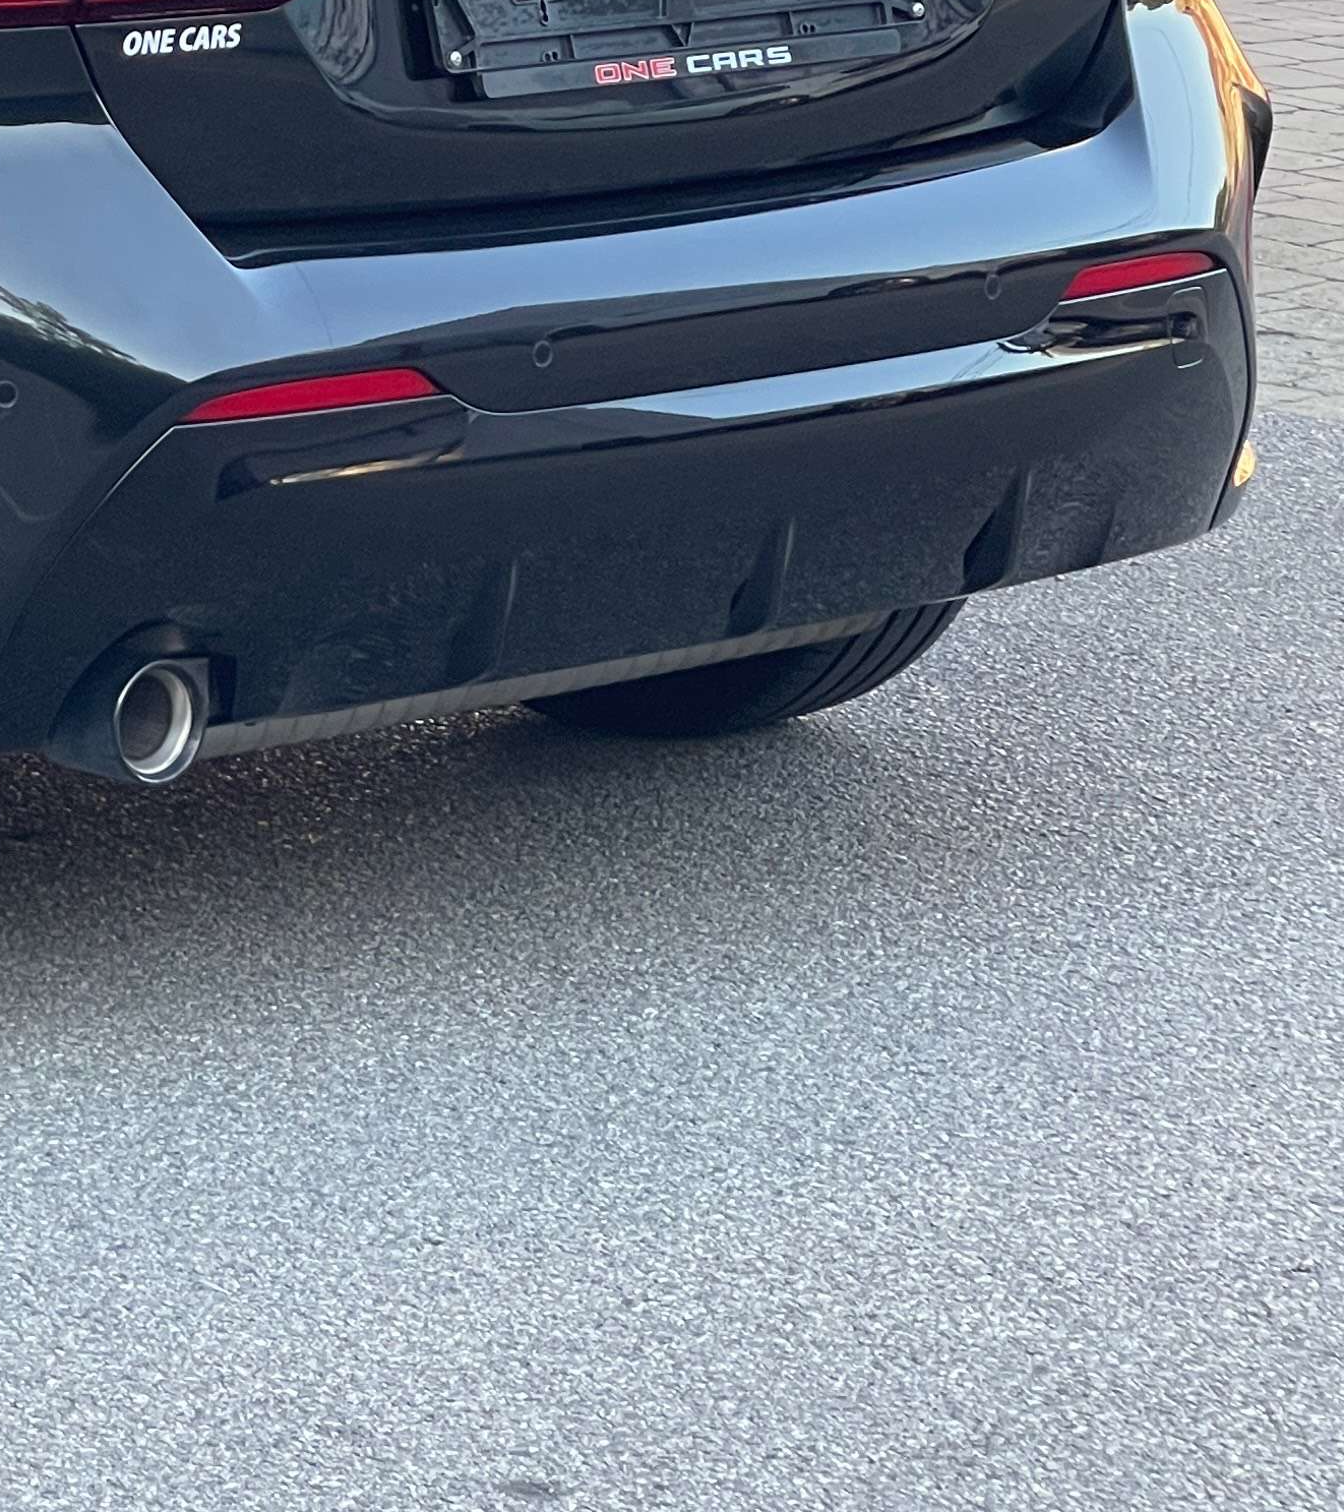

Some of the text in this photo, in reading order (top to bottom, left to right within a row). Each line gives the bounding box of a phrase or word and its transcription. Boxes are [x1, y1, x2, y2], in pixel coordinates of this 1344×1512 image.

[122, 22, 243, 56] ONE CARS
[594, 45, 793, 85] ONE CARS
